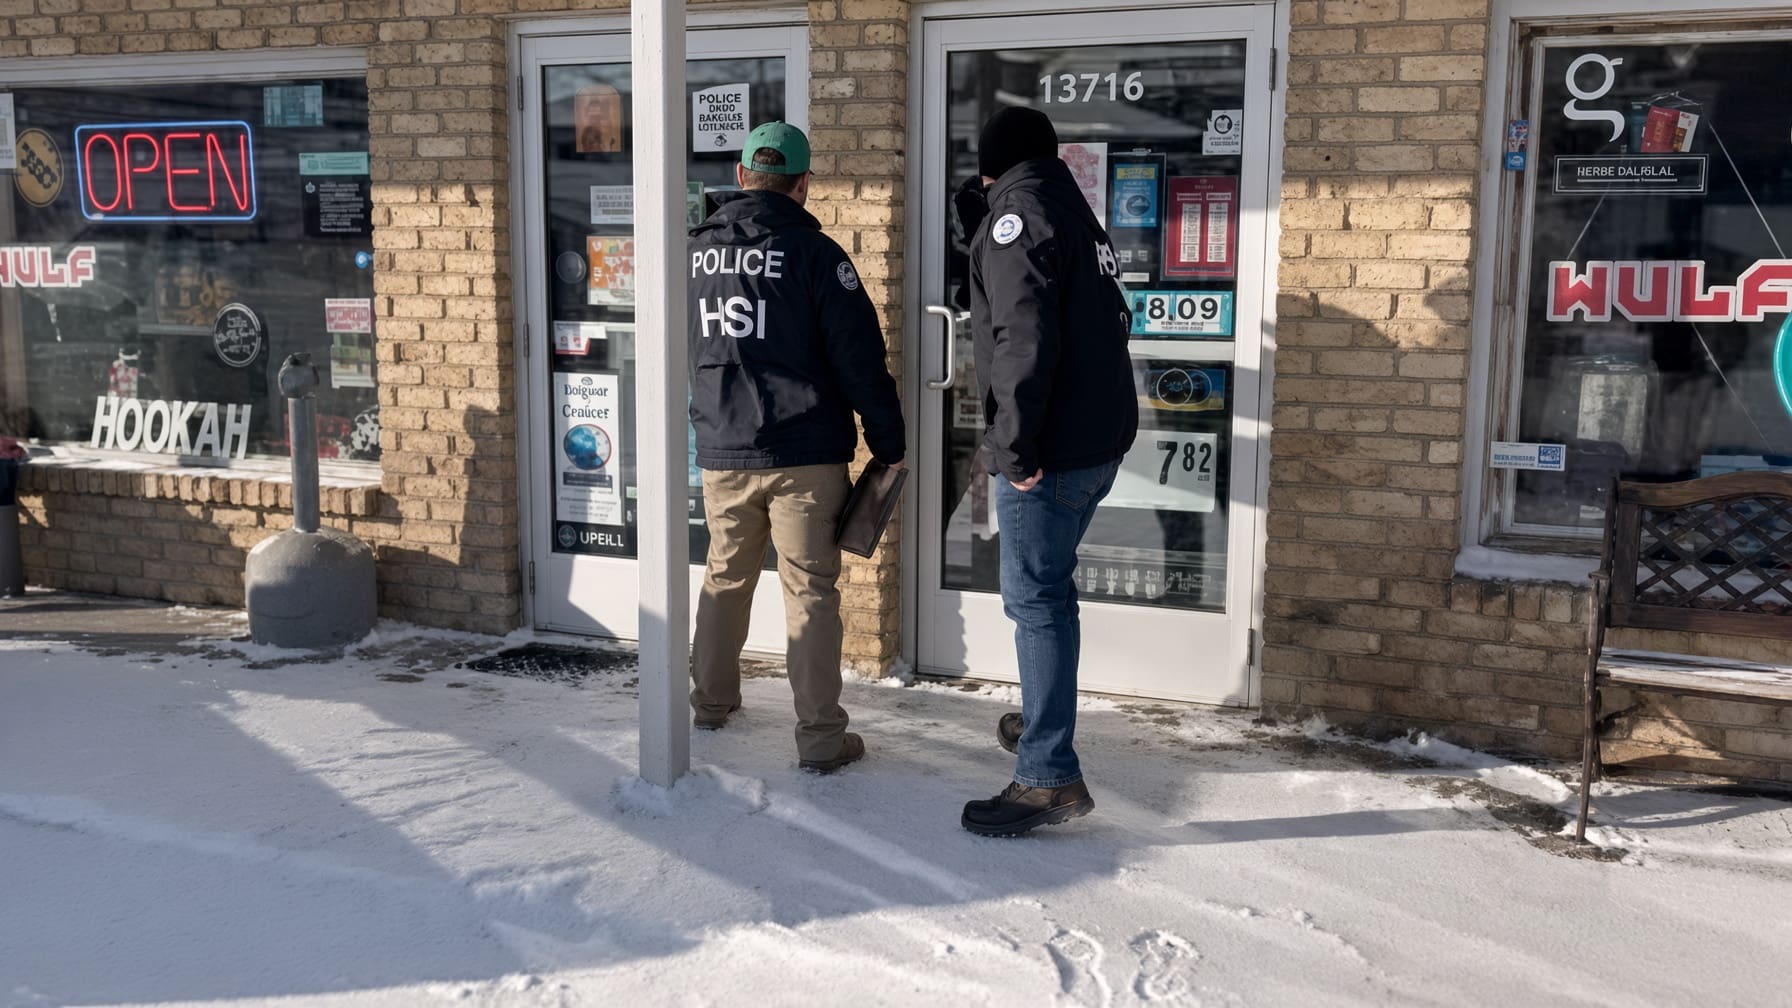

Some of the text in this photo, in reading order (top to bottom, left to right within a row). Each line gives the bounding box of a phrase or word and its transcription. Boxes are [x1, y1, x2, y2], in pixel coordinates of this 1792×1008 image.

[699, 93, 742, 104] POLICE
[1039, 72, 1144, 104] 13716
[85, 133, 248, 211] OPEN
[1577, 166, 1615, 176] HERBE
[692, 247, 785, 278] POLICE
[699, 295, 766, 340] HSI
[1148, 297, 1219, 321] 8.09
[90, 396, 252, 460] HOOKAH
